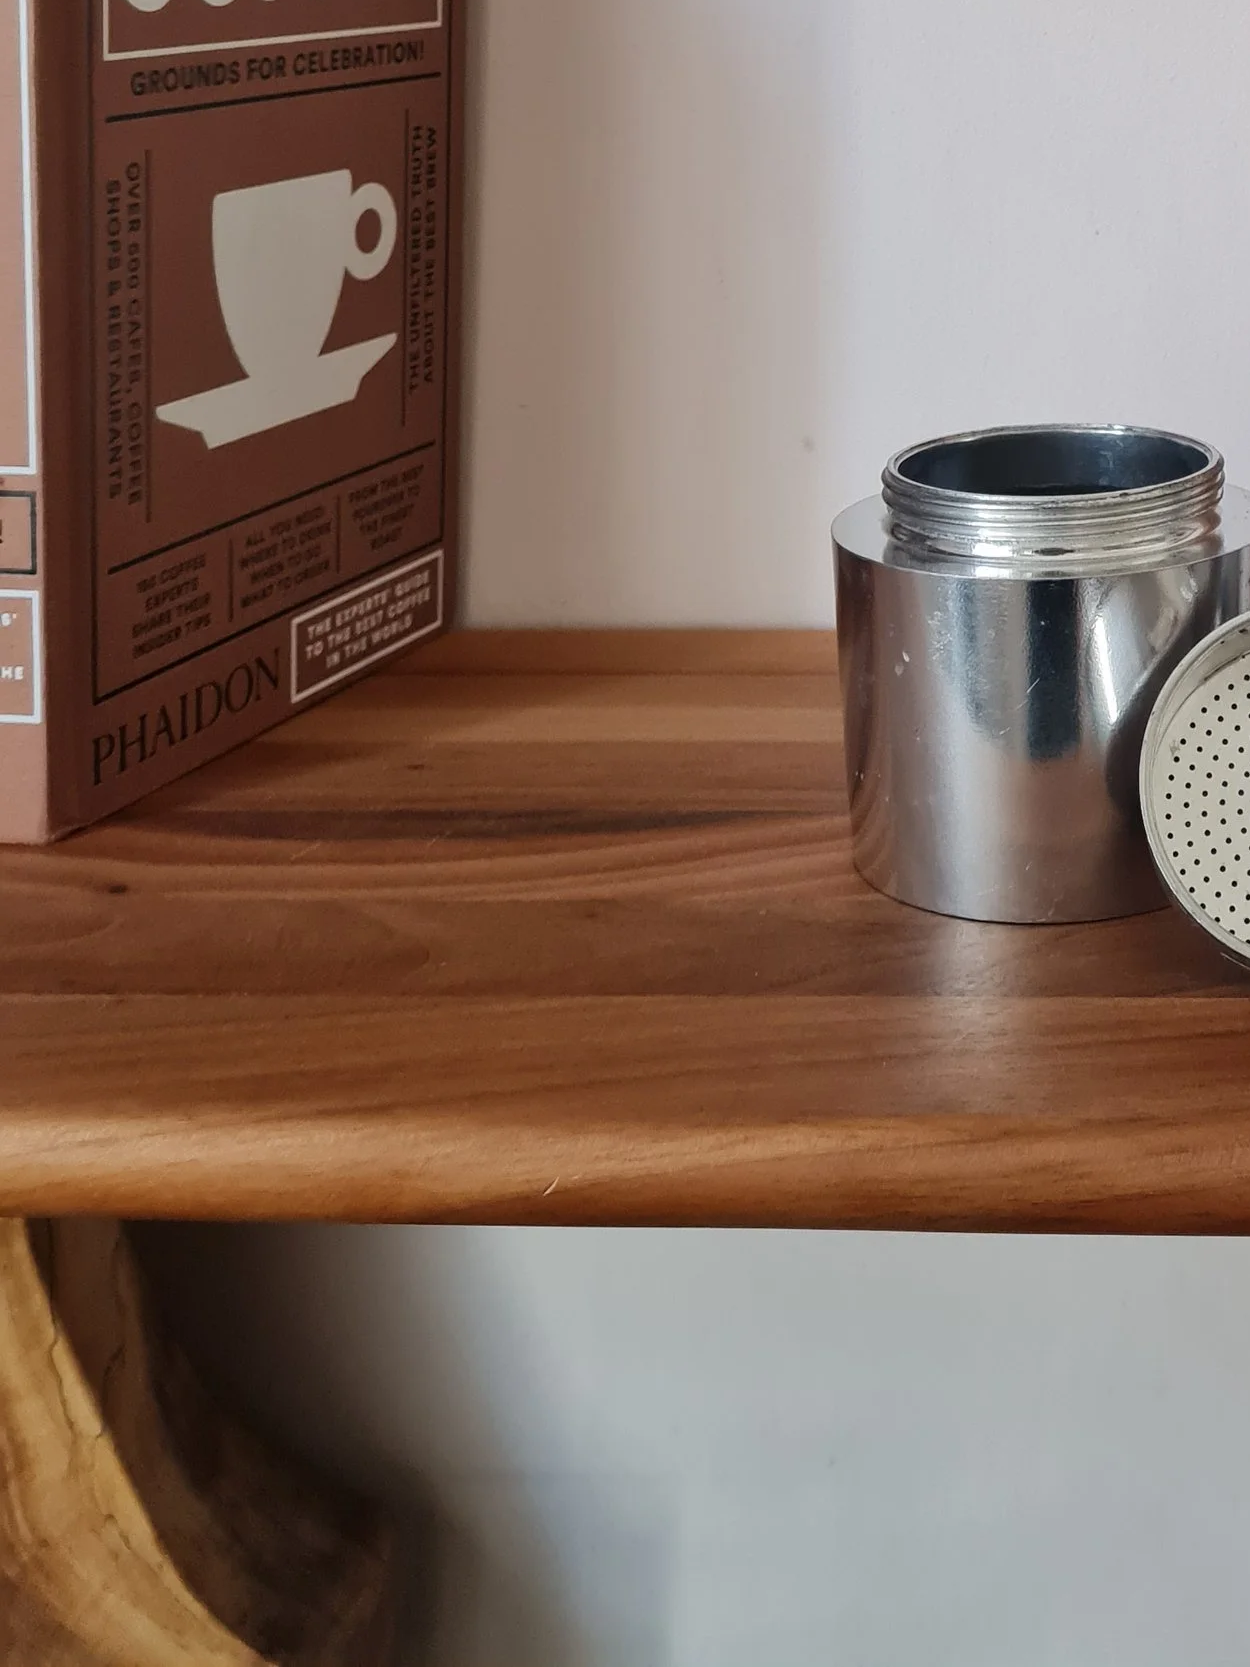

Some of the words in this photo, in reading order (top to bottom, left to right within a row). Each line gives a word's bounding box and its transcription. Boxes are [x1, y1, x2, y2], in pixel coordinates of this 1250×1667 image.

[131, 61, 241, 96] GROUNDS
[246, 54, 288, 81] FOR
[292, 40, 425, 76] CELEBRATION!
[106, 179, 121, 271] SHOPS
[126, 161, 141, 232] OVER
[108, 304, 122, 499] RESTAURANTS
[91, 646, 282, 786] PHAIDON
